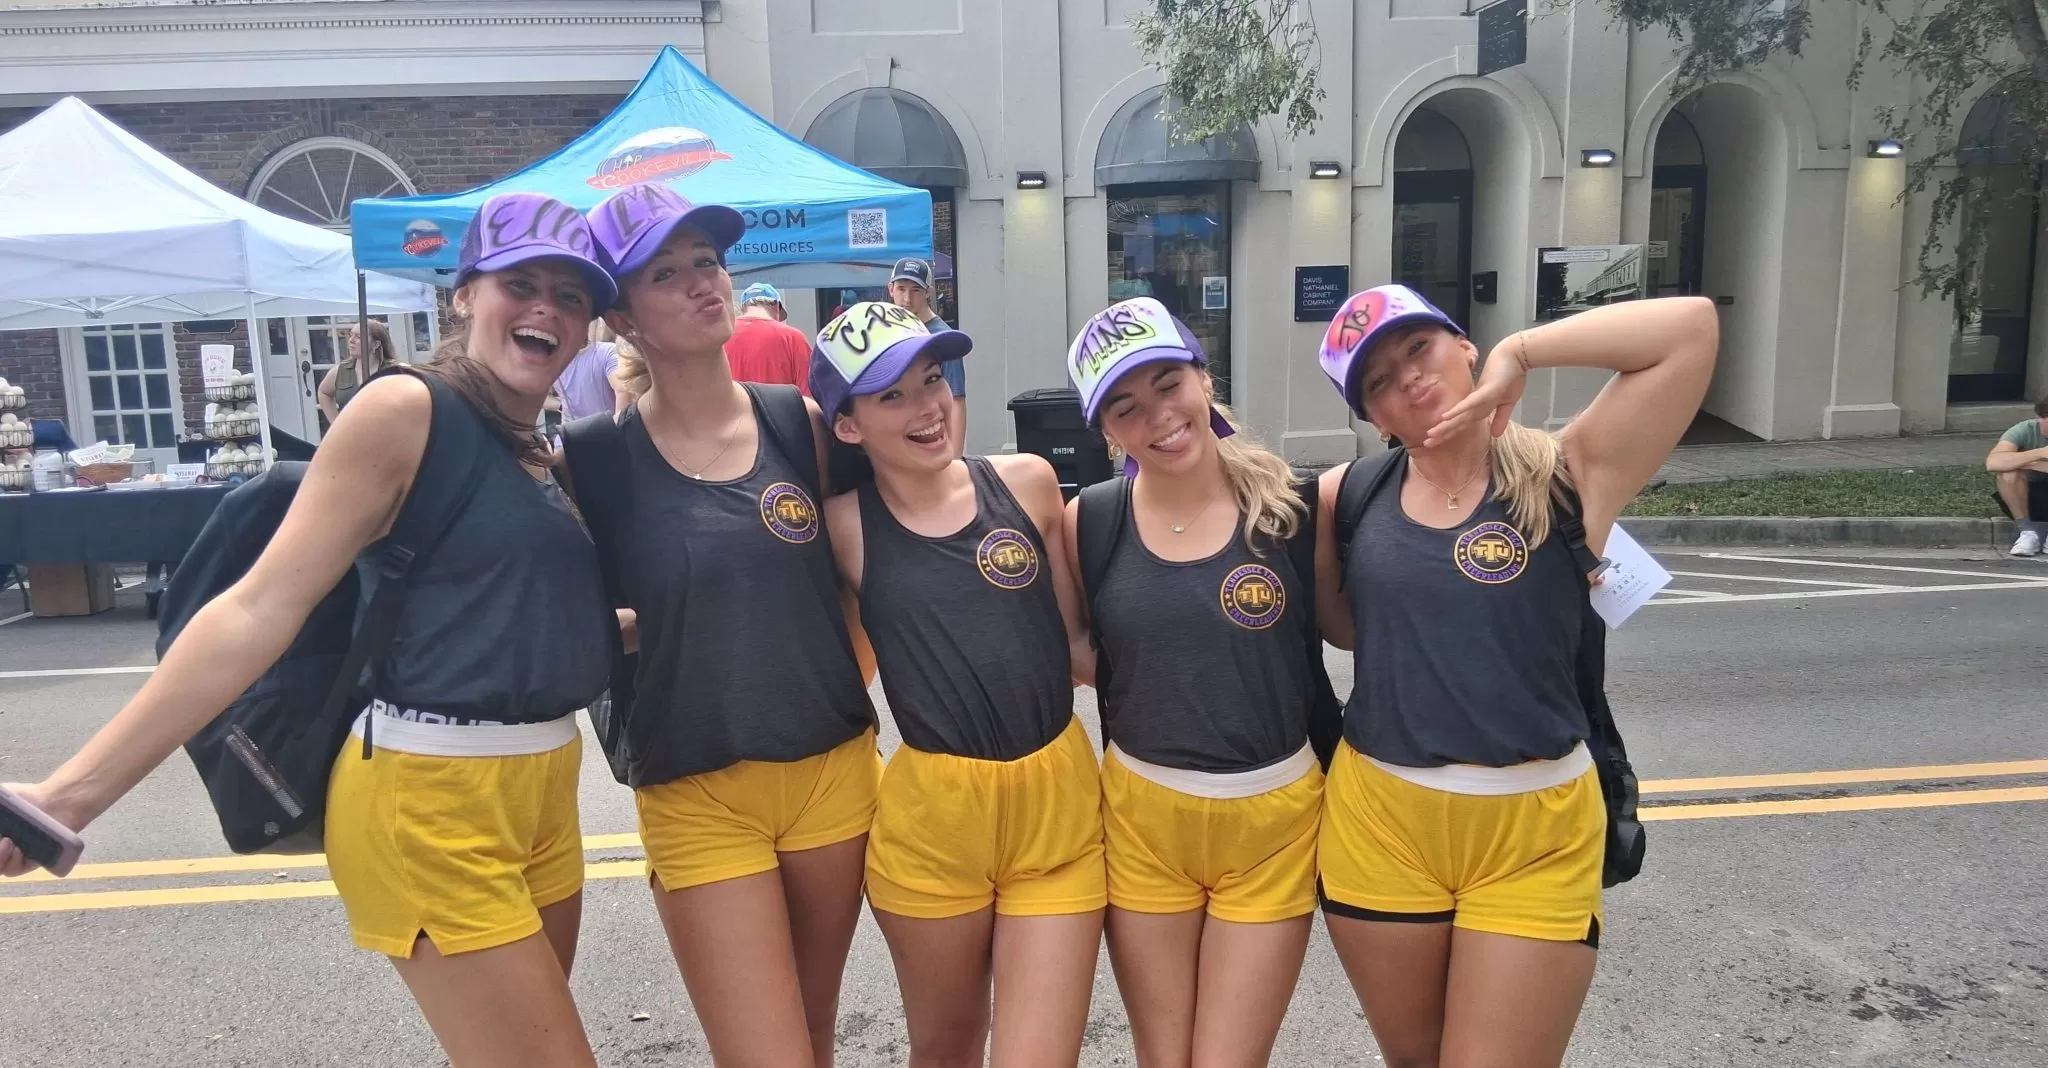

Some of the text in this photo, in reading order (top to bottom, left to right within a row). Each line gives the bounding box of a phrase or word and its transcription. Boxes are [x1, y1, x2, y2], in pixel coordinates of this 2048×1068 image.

[601, 151, 718, 188] COOKEVILLE
[488, 199, 590, 255] Ella
[734, 241, 814, 255] RESOURCES
[1338, 303, 1372, 353] Jo
[1460, 524, 1505, 547] TENNESSEE
[1472, 539, 1510, 562] TTU
[1225, 567, 1262, 592] TENNESSEE
[1462, 560, 1521, 581] CHEERLEADING
[1237, 583, 1272, 607] TTU
